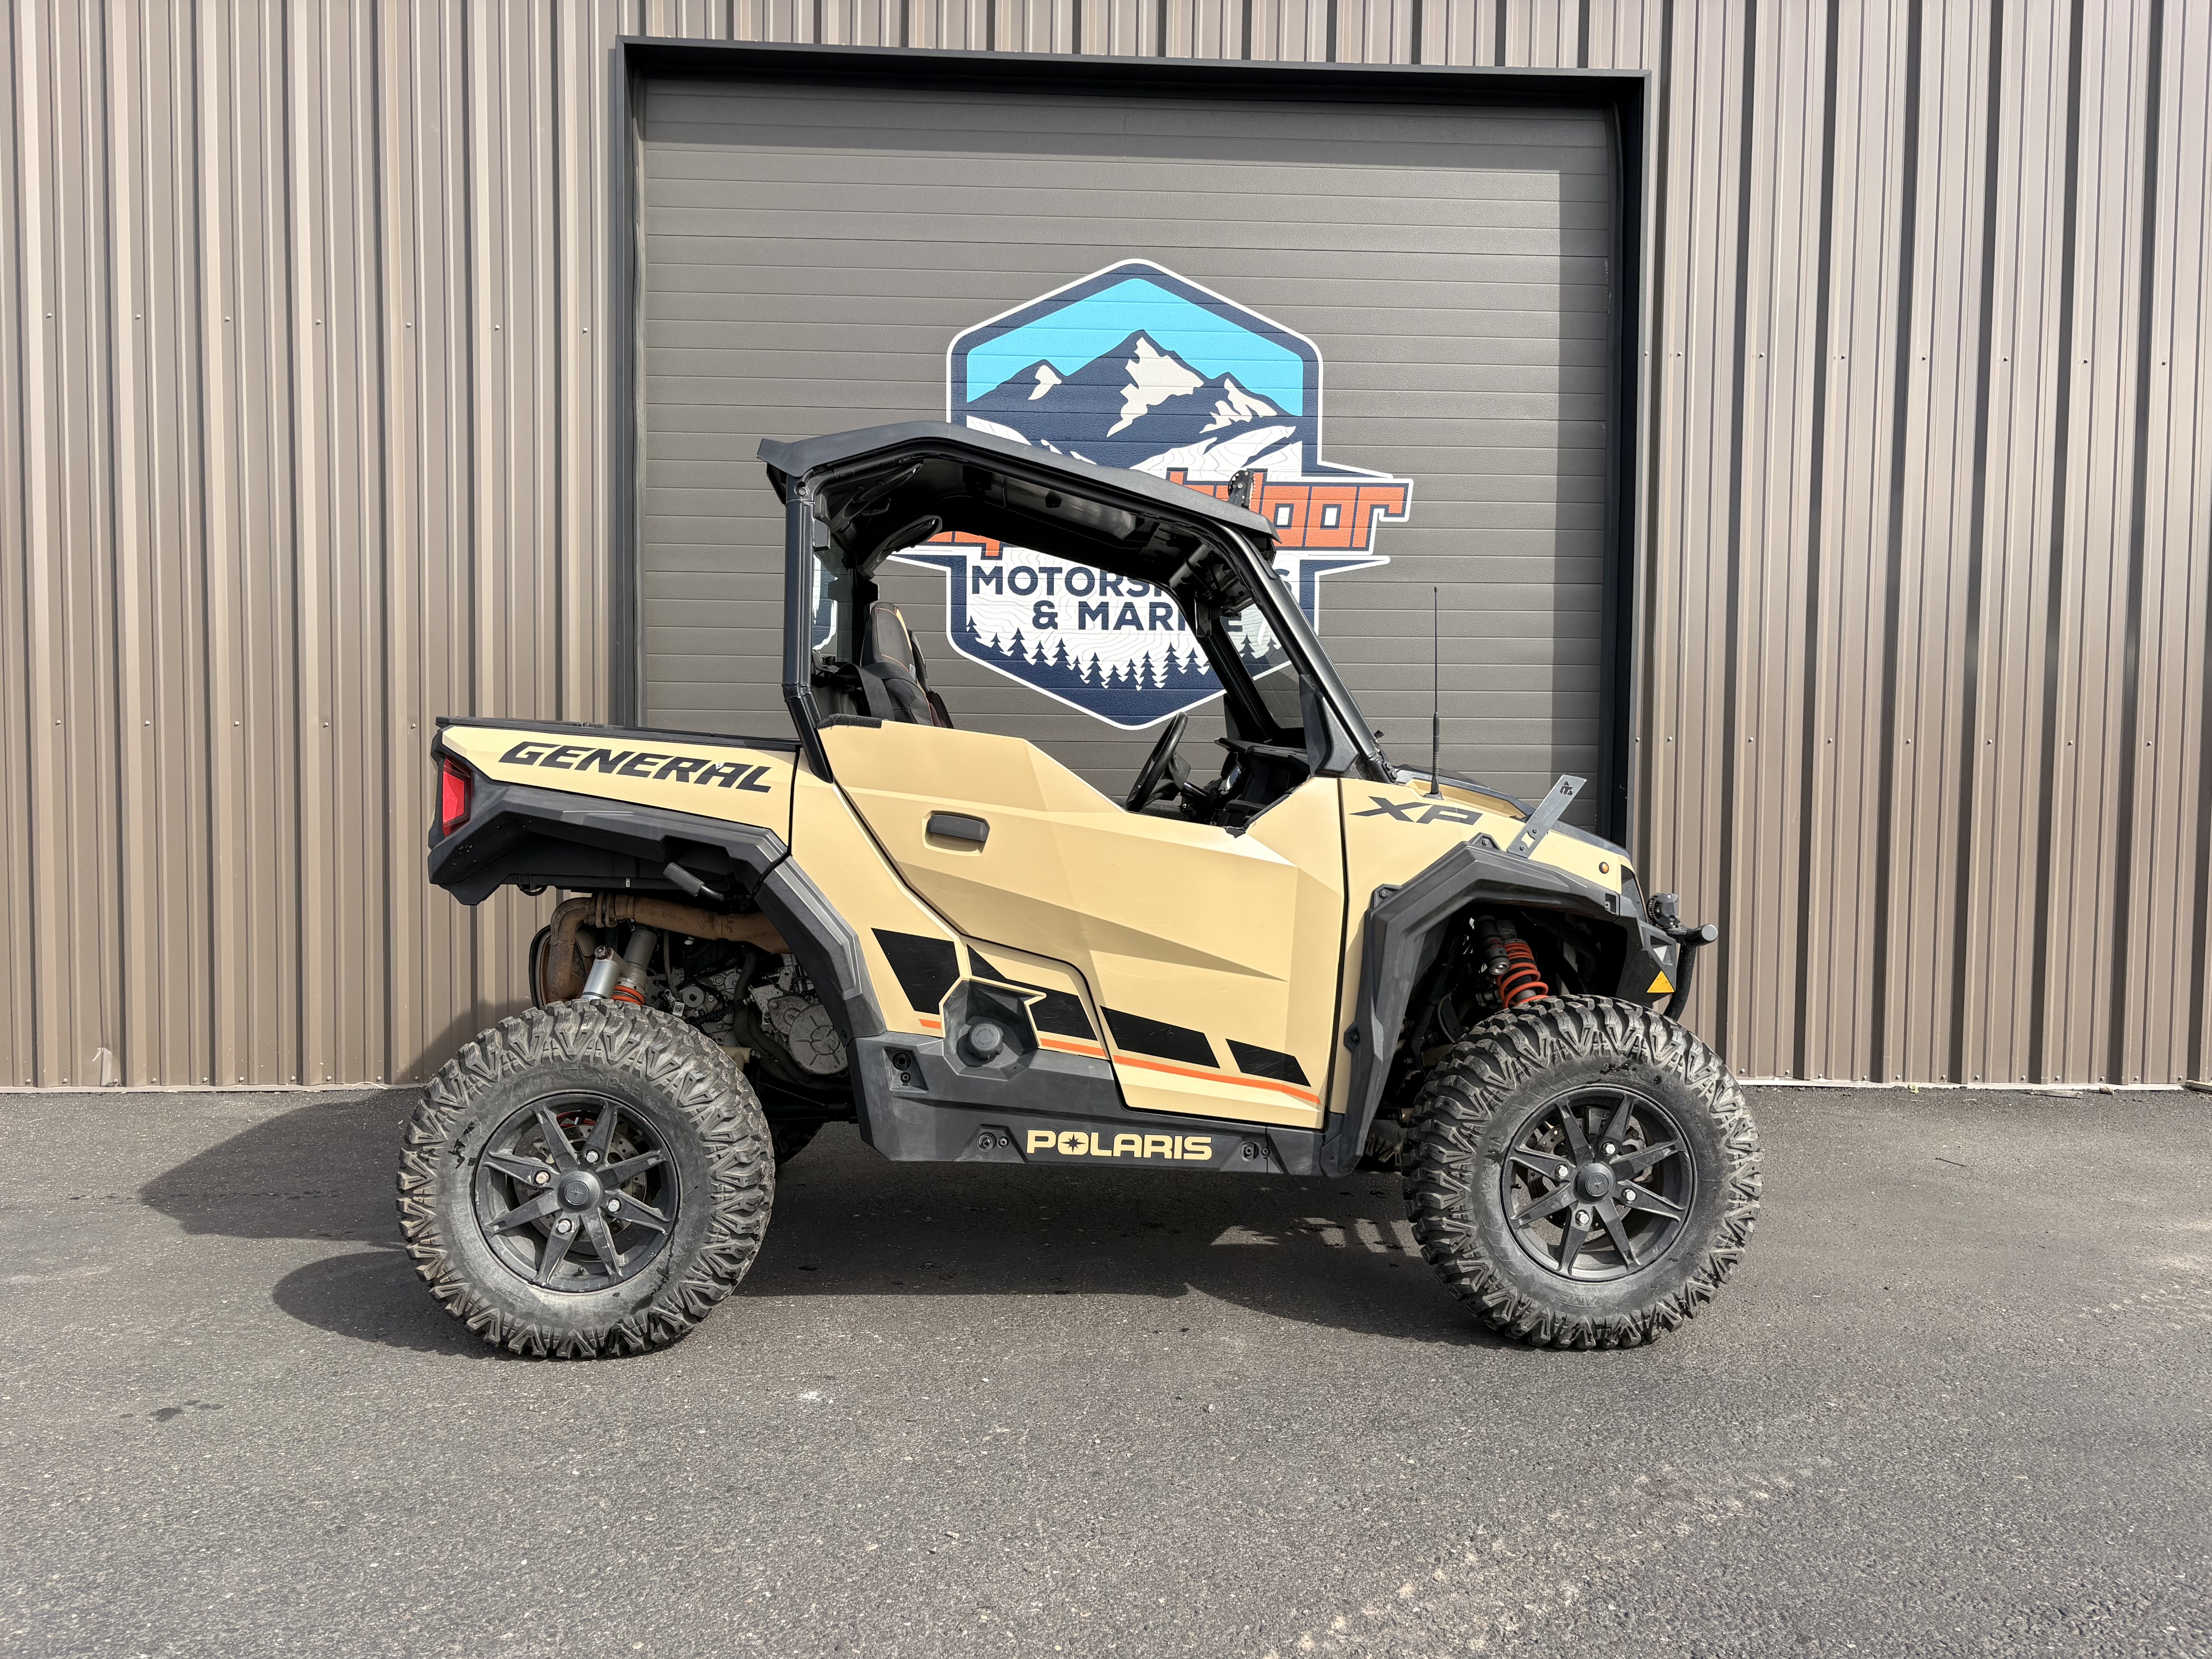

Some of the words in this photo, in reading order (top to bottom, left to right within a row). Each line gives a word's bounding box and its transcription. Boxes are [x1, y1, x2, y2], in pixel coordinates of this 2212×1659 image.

[1032, 600, 1058, 630] &
[499, 741, 771, 793] GENERAL
[1348, 796, 1483, 825] XP
[1027, 1130, 1212, 1160] POLARIS
